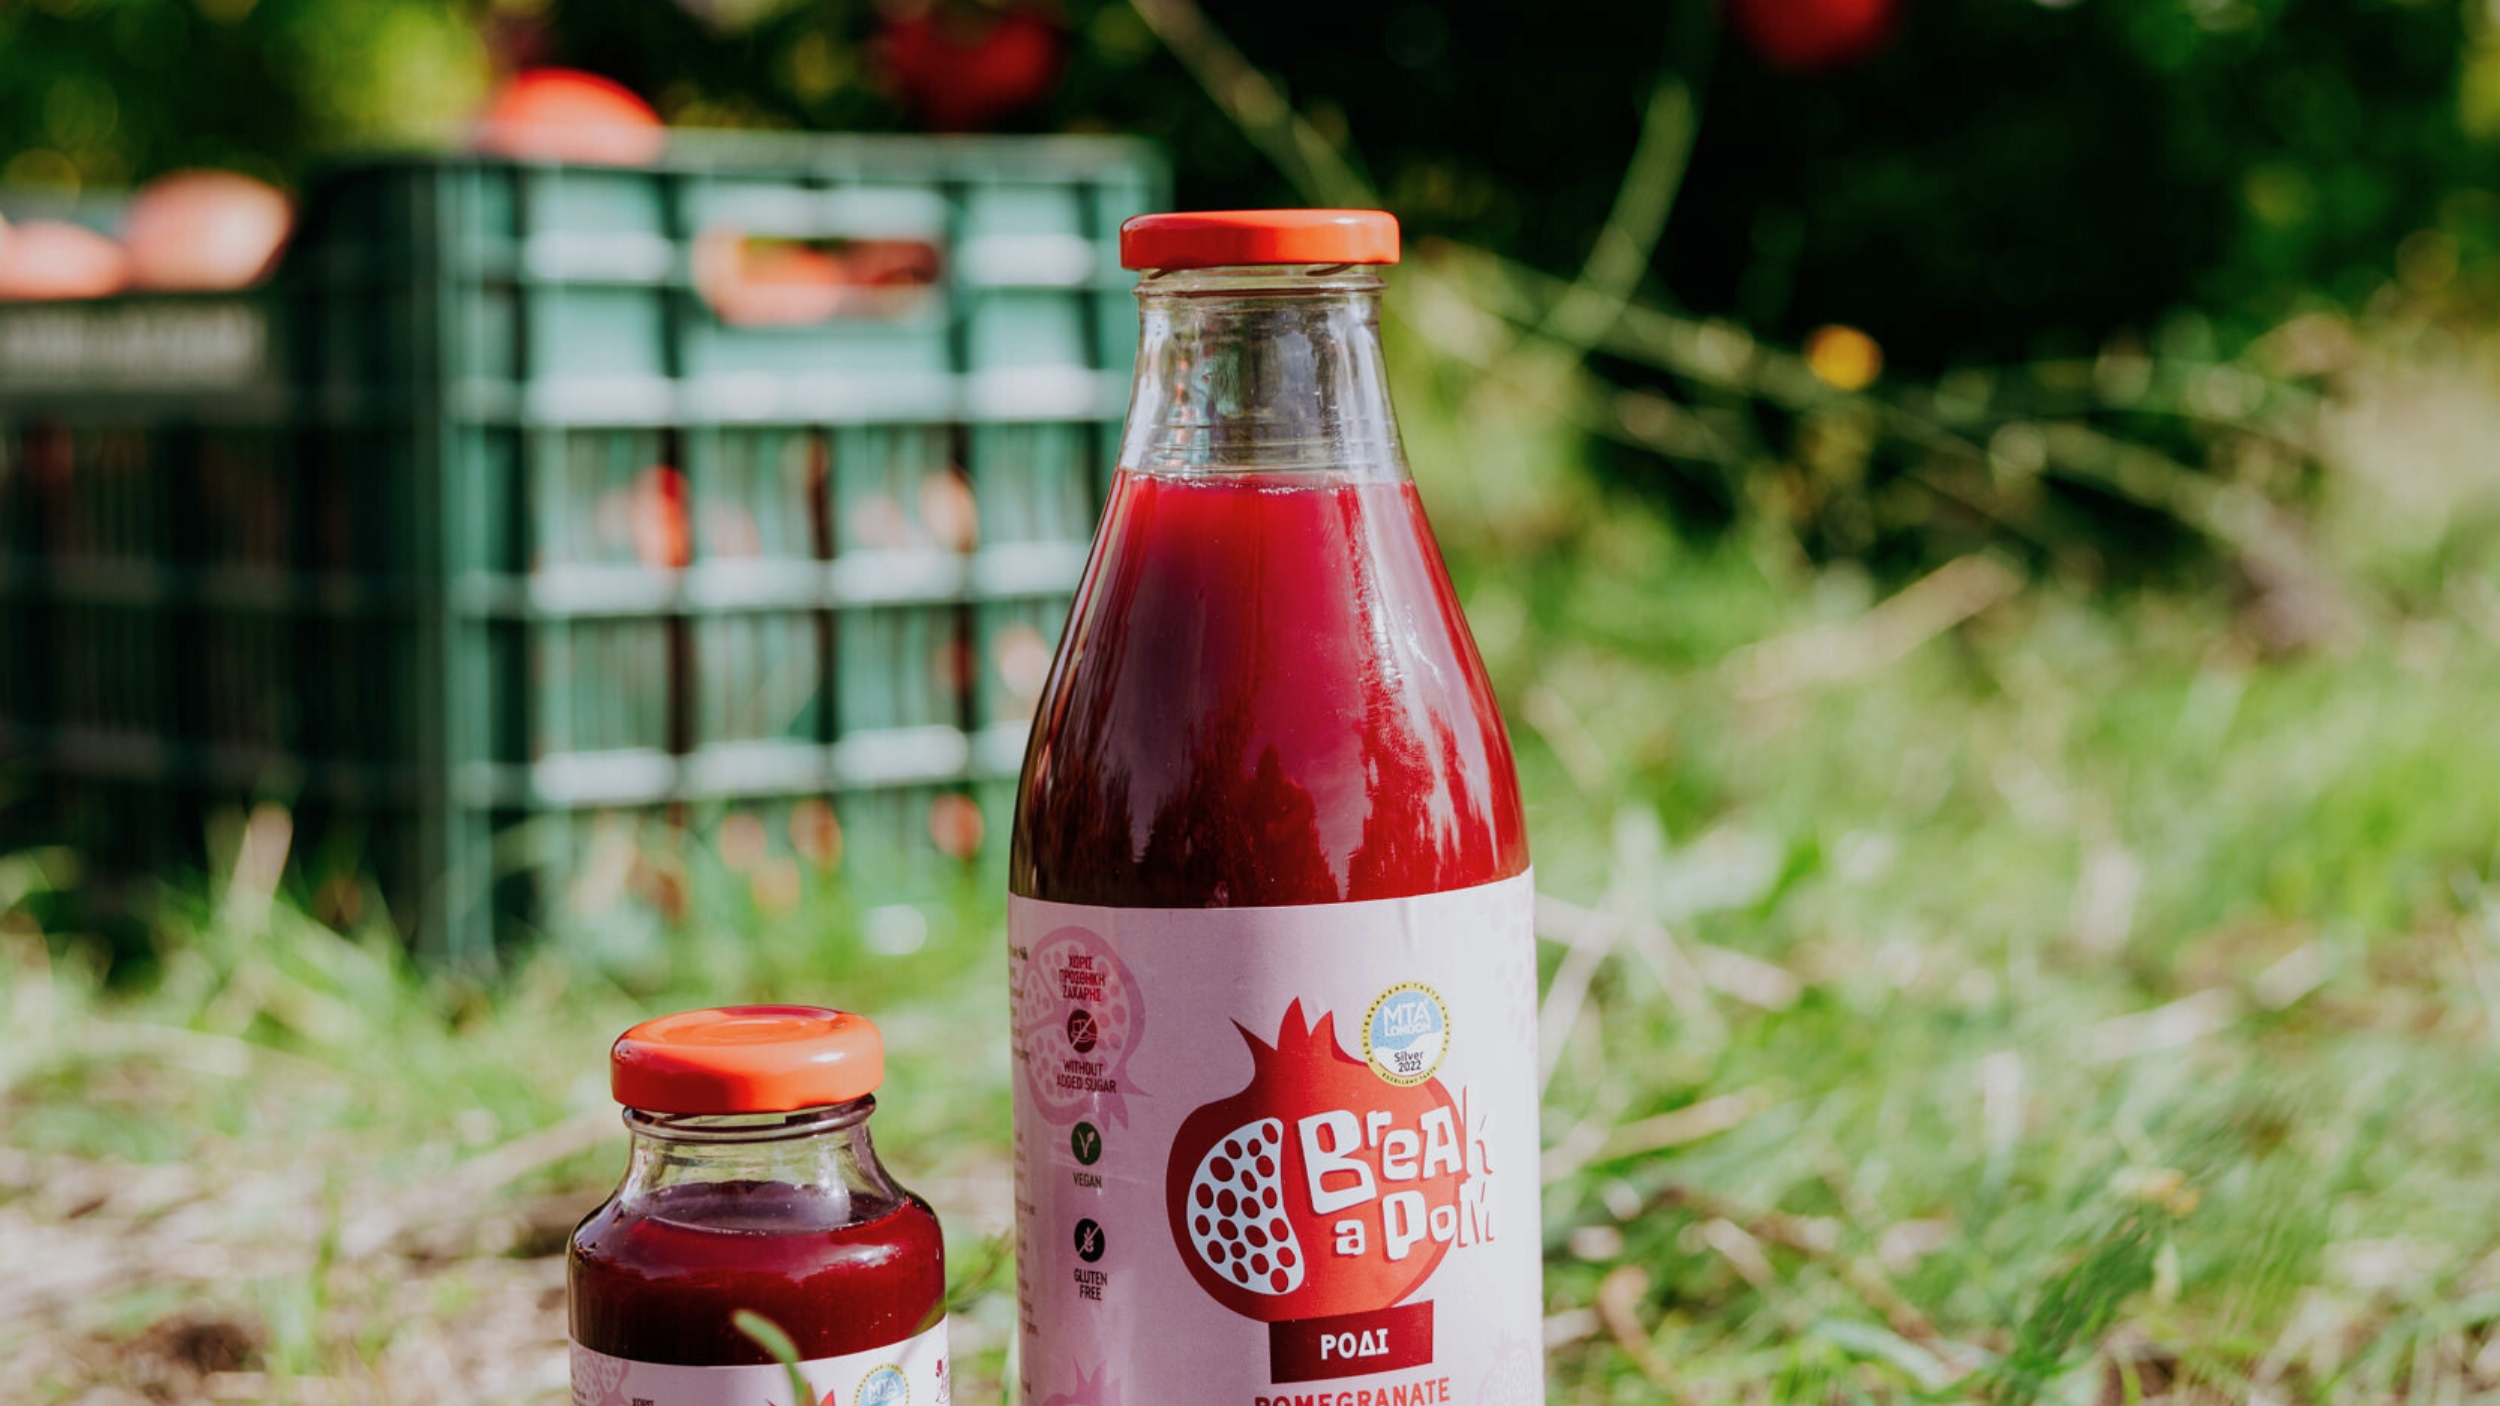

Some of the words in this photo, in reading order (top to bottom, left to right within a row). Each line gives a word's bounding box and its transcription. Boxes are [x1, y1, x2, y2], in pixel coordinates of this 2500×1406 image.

[1383, 1001, 1431, 1026] MTA
[1384, 1022, 1432, 1037] LONDON
[1394, 1050, 1424, 1063] Silver
[1063, 1059, 1103, 1076] WITHOUT
[1398, 1060, 1421, 1073] 2022
[1056, 1074, 1083, 1090] ADDED
[1085, 1078, 1116, 1093] SUGAR
[1073, 1171, 1102, 1188] VEGAN
[1334, 1218, 1366, 1257] a
[1074, 1268, 1107, 1286] GLUTEN
[1079, 1284, 1102, 1301] FREE
[1320, 1328, 1389, 1360] ΡΟΔΙ
